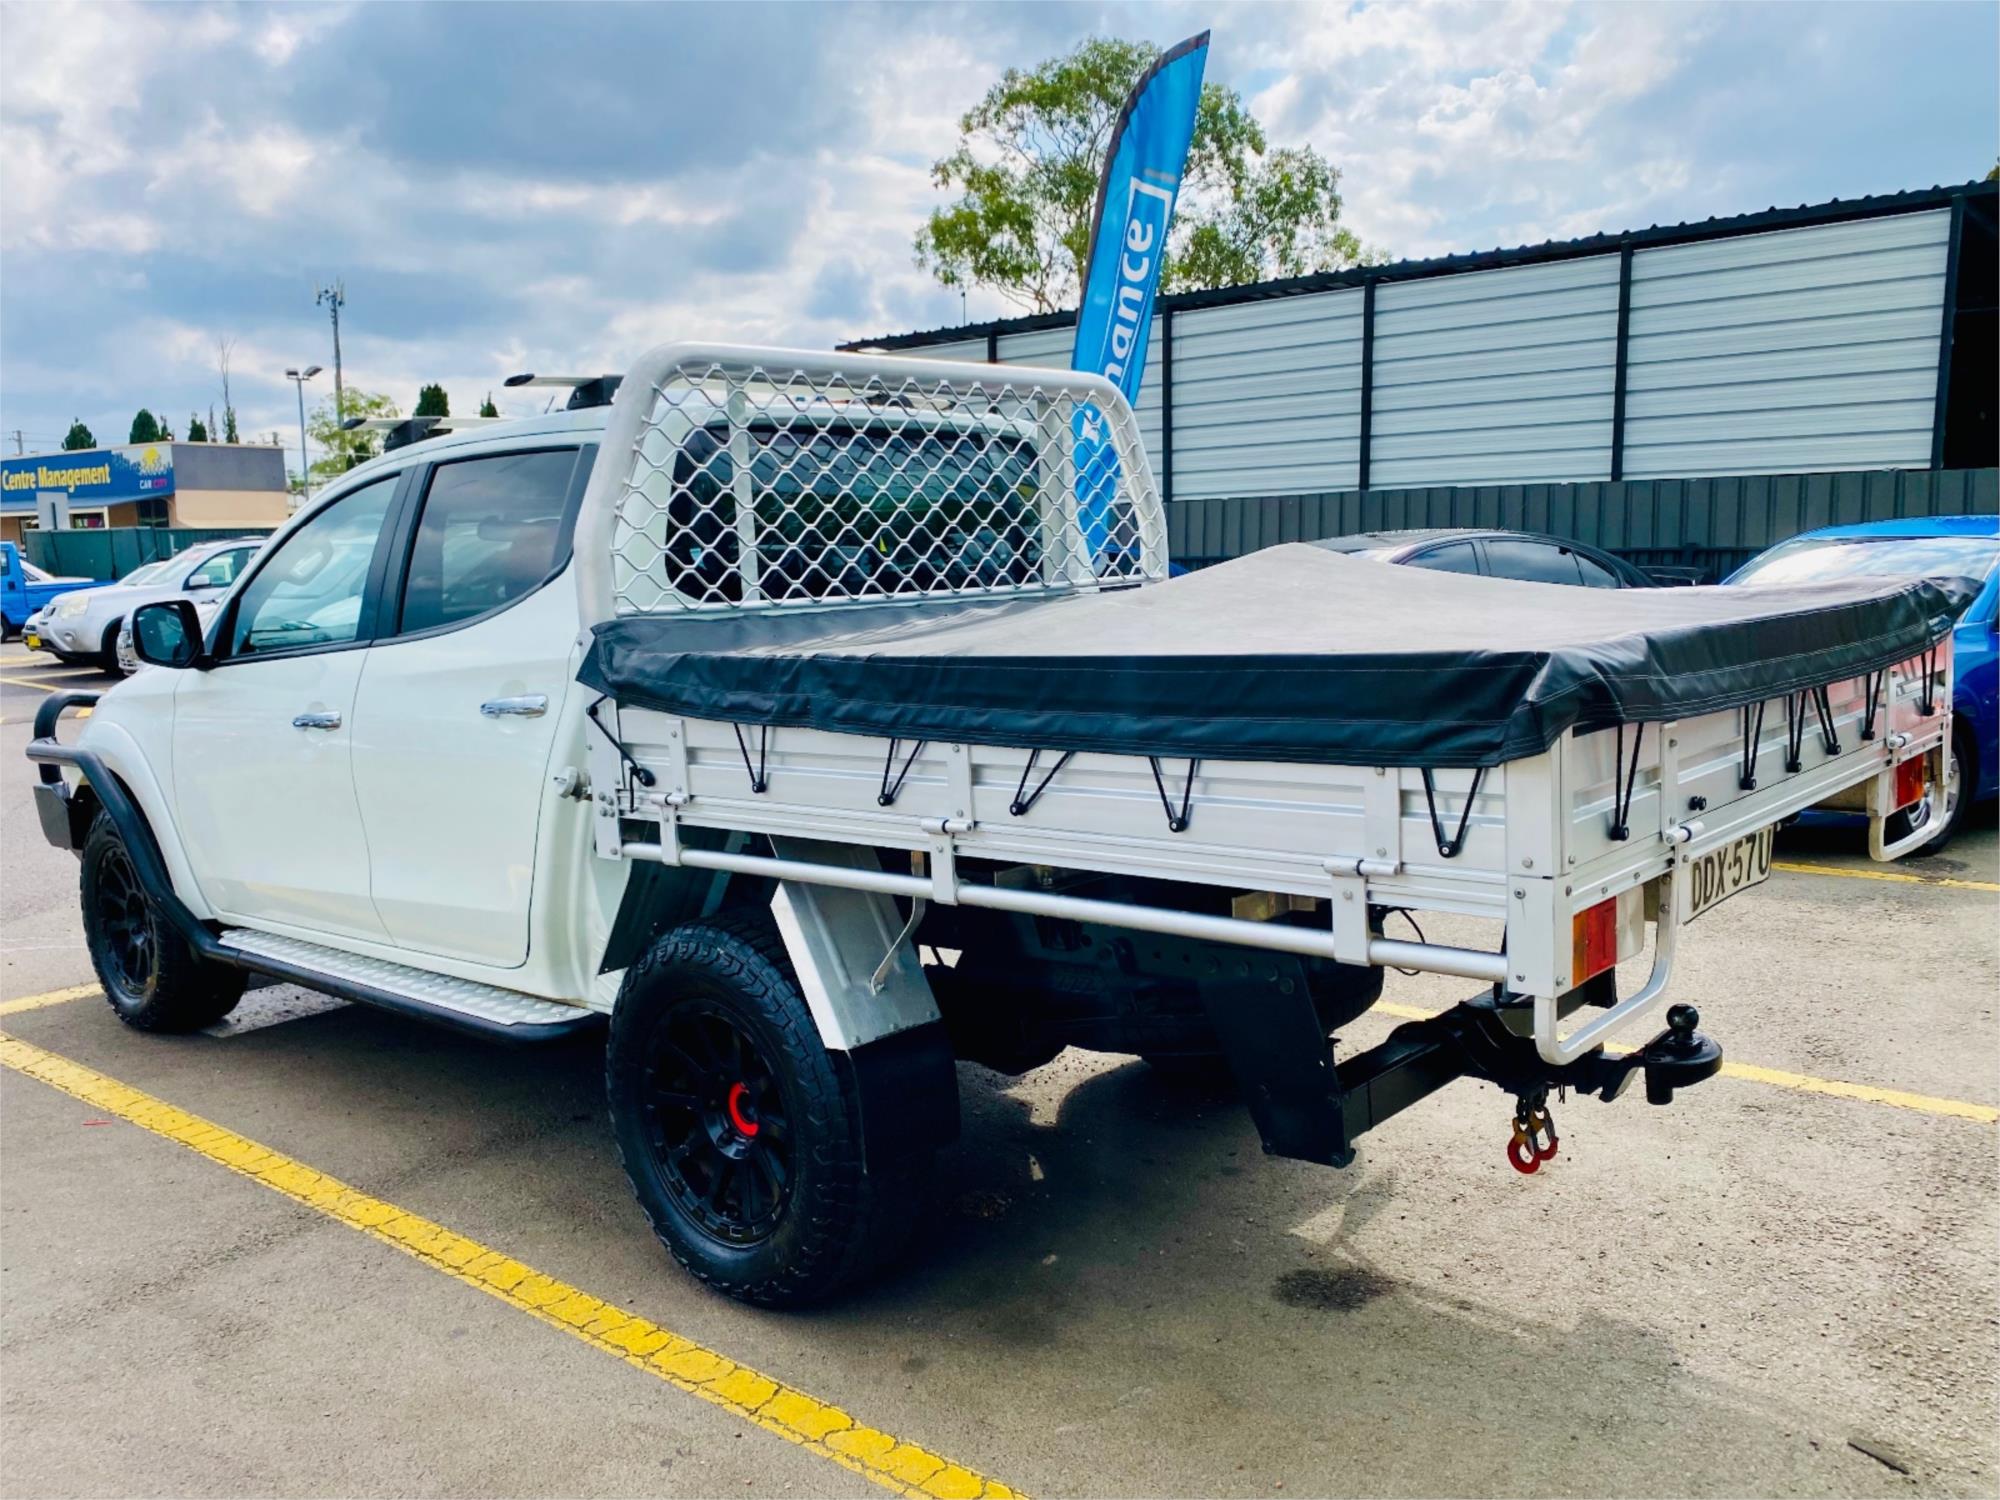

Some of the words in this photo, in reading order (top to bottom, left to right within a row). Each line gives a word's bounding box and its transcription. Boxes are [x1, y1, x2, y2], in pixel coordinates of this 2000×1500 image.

[2, 470, 36, 491] Centre
[37, 462, 111, 493] Management
[139, 479, 153, 490] CAR
